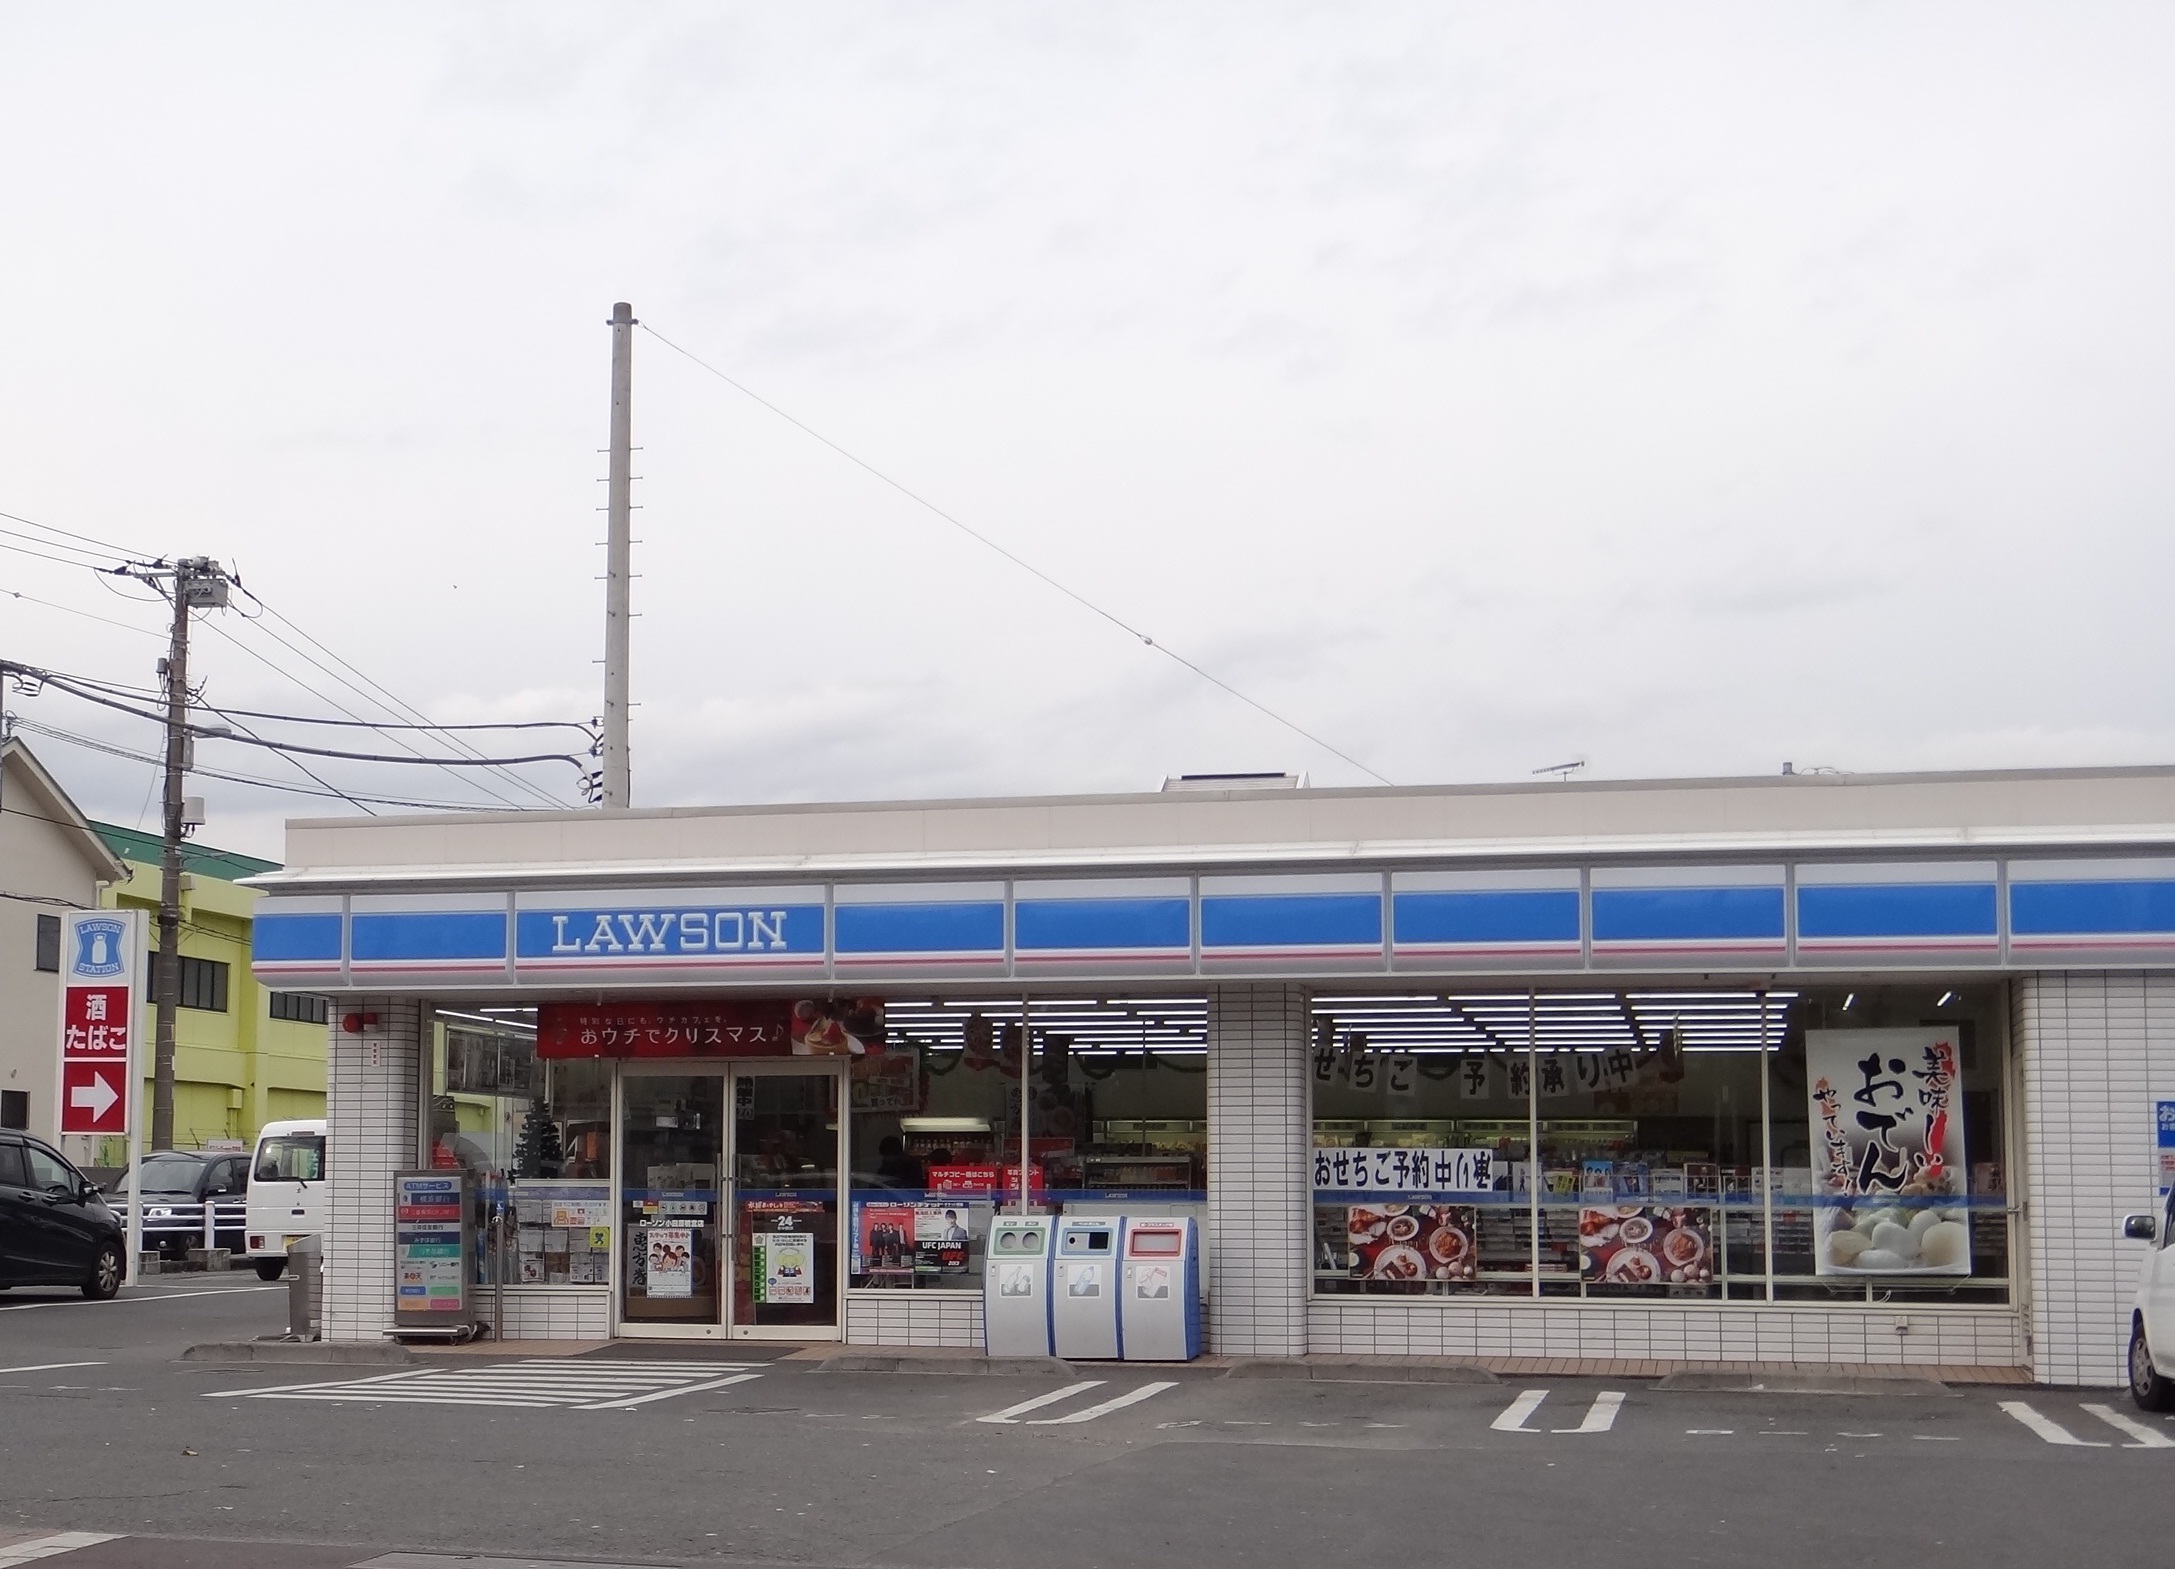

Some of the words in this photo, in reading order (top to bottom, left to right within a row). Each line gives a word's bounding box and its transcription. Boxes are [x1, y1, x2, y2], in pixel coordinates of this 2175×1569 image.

[79, 922, 122, 935] LAWSON
[552, 911, 788, 953] LAWSON
[78, 961, 120, 974] STATION
[85, 993, 108, 1021] 酒
[65, 1024, 127, 1051] たばこ
[1912, 1046, 1951, 1168] 美味しい
[1853, 1052, 1914, 1195] おでん
[777, 1215, 793, 1227] 24
[922, 1241, 937, 1249] UFC
[937, 1241, 962, 1251] JAPAN
